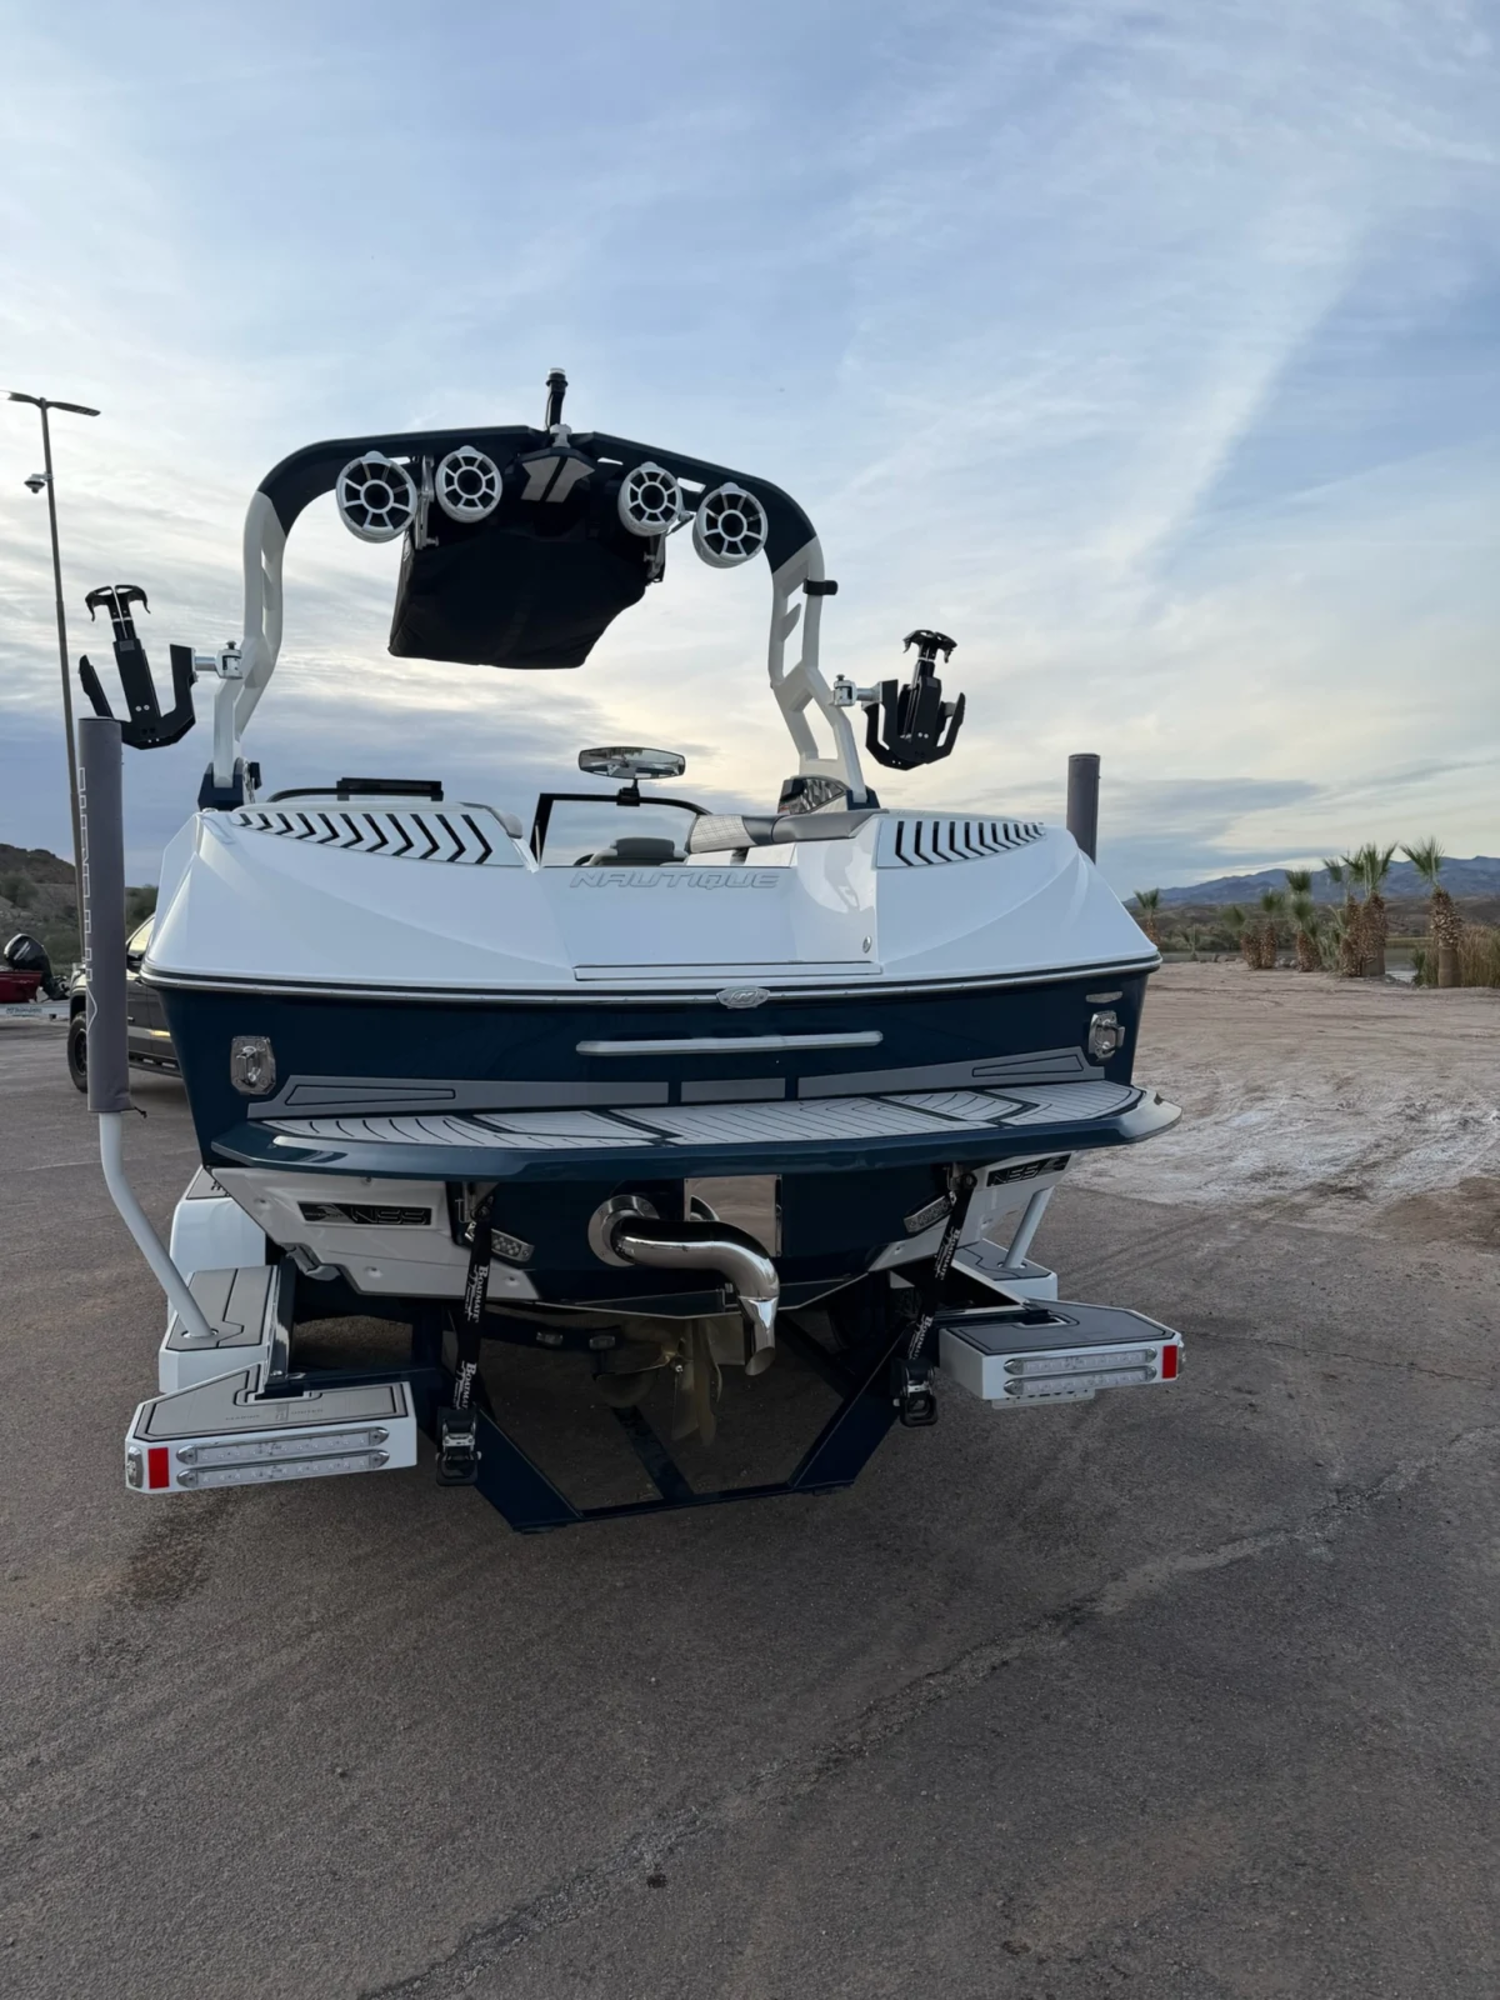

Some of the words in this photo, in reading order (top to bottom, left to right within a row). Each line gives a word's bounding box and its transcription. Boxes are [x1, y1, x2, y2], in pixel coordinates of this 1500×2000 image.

[569, 870, 782, 890] NAUTIQUE
[473, 1265, 489, 1320] BOATMATE
[914, 1315, 934, 1359] BOATMAT
[462, 1362, 477, 1409] BOATMAT
